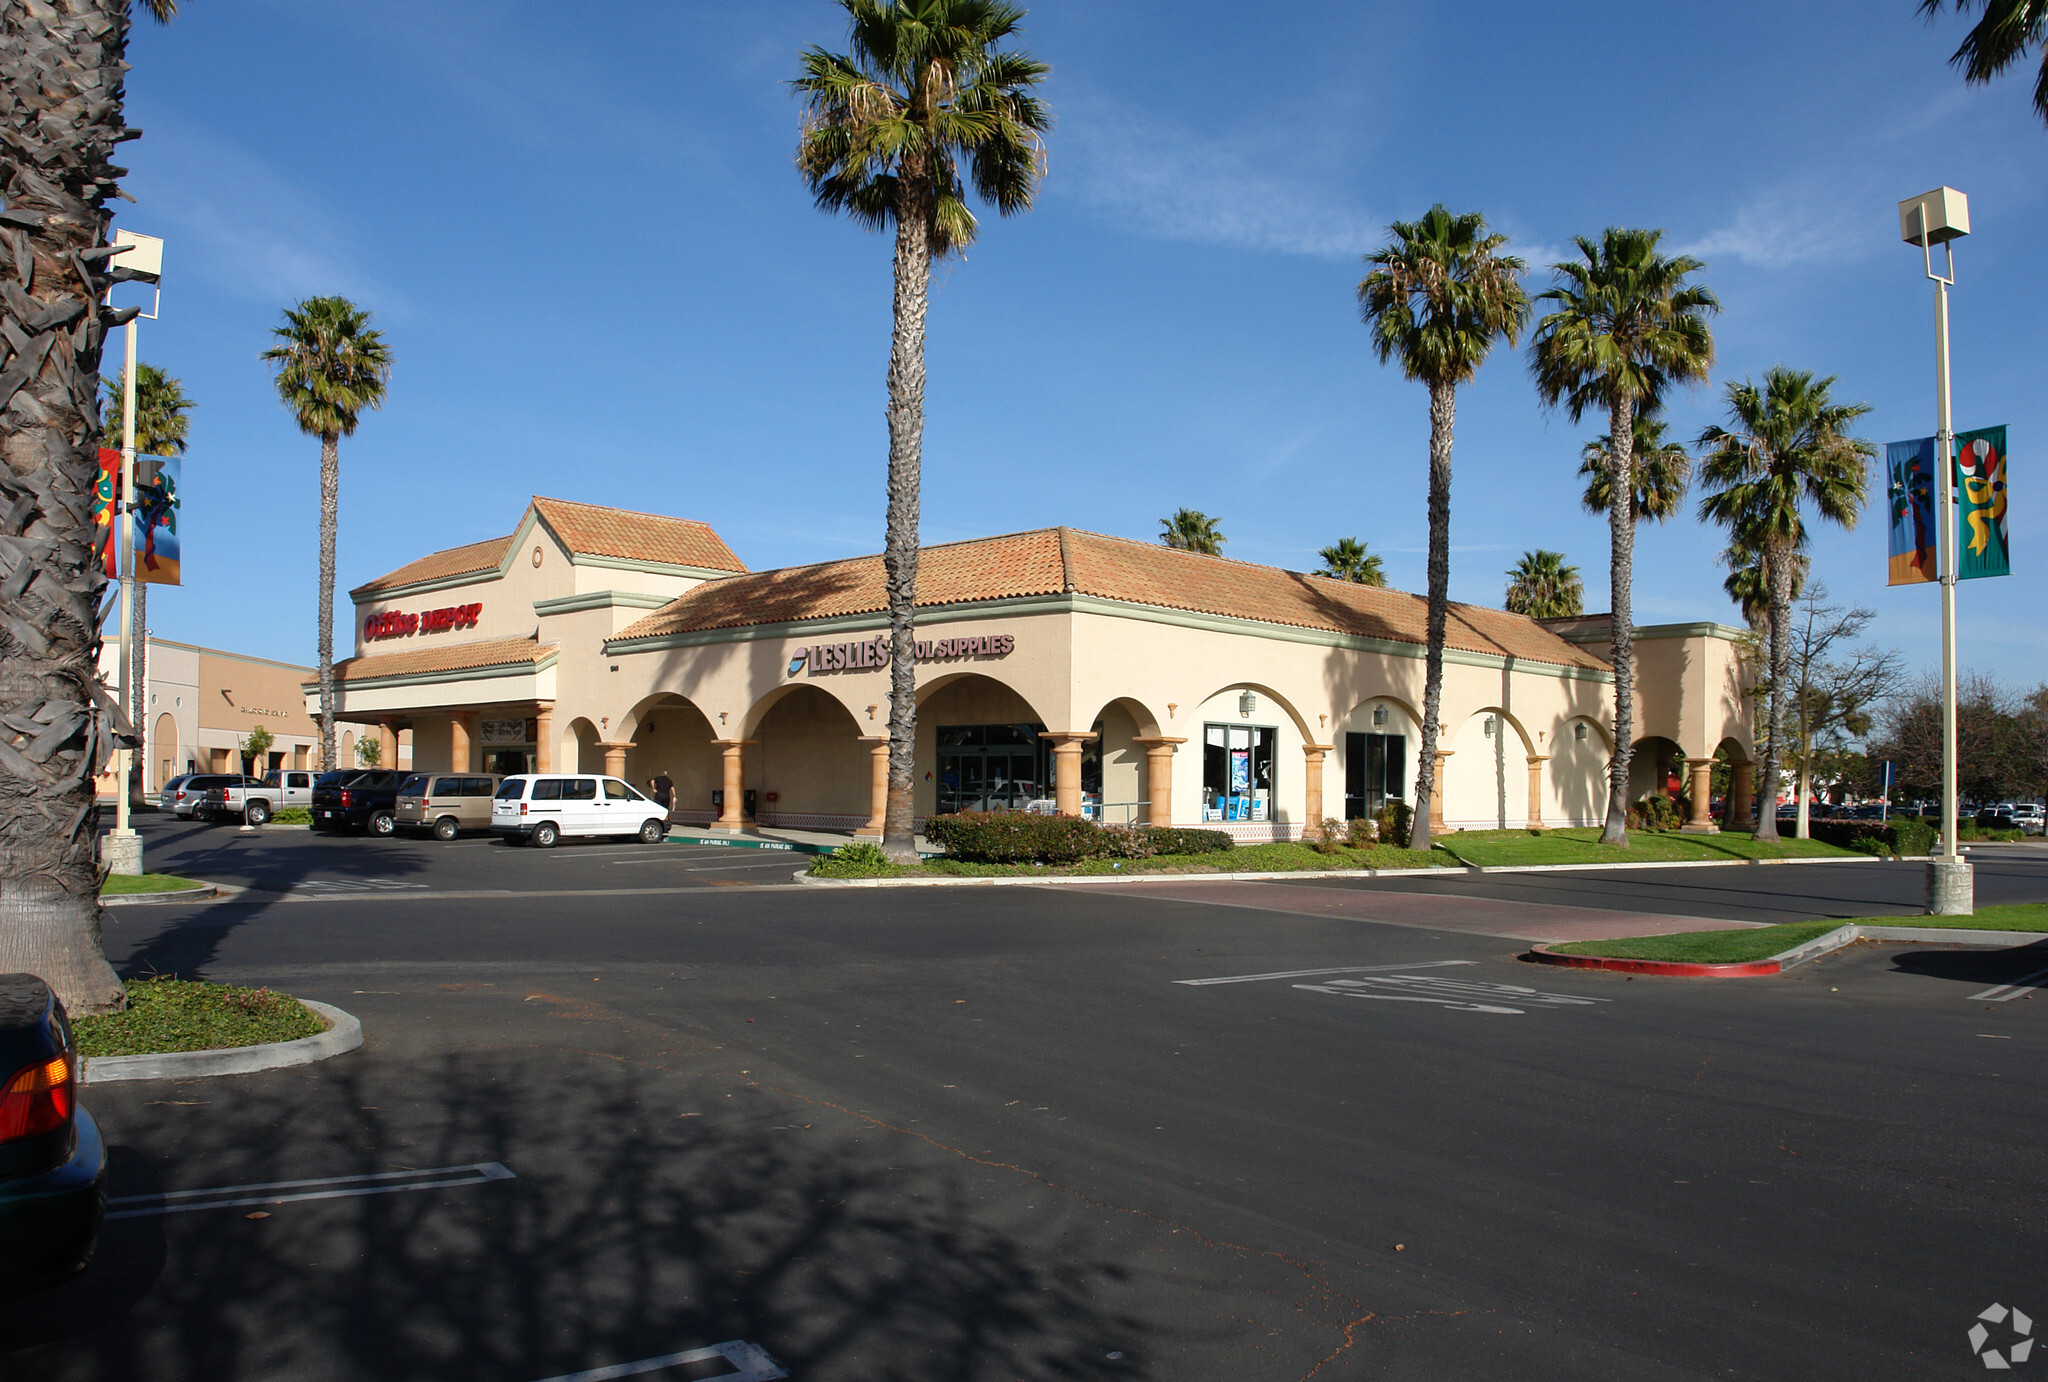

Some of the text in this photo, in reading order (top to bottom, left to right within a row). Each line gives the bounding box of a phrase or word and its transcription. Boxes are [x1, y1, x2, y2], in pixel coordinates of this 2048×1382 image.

[364, 602, 482, 639] Office DEPOT
[810, 635, 888, 671] LESLIE'S
[937, 634, 1014, 657] SUPPLIES
